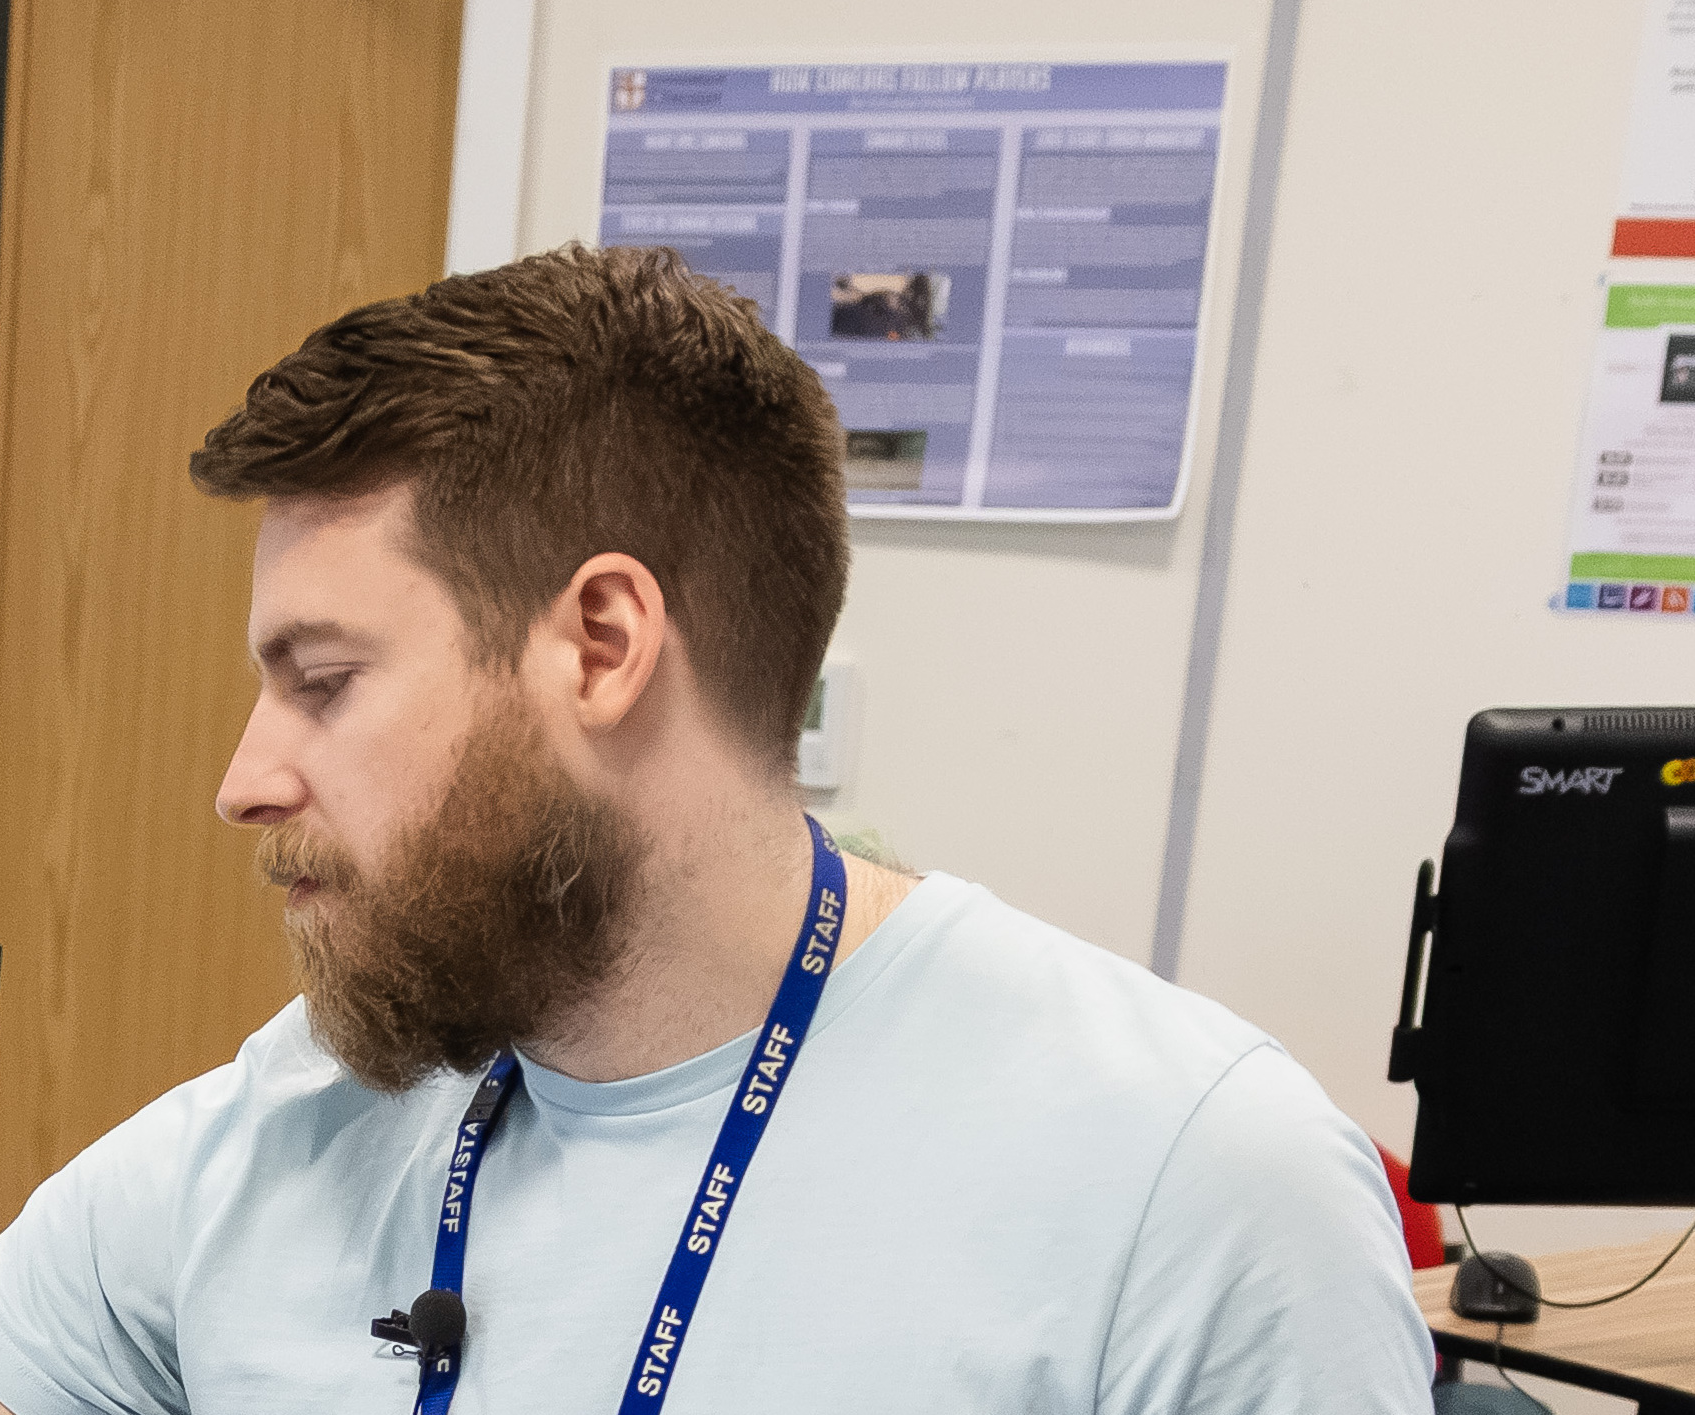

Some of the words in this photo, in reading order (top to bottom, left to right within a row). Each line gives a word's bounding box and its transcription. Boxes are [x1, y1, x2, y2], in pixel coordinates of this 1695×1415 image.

[1517, 766, 1625, 795] SMART
[801, 888, 843, 975] STAFF
[742, 1024, 794, 1115] STAFF
[687, 1163, 736, 1255] STAFF
[637, 1305, 683, 1397] STAFF
